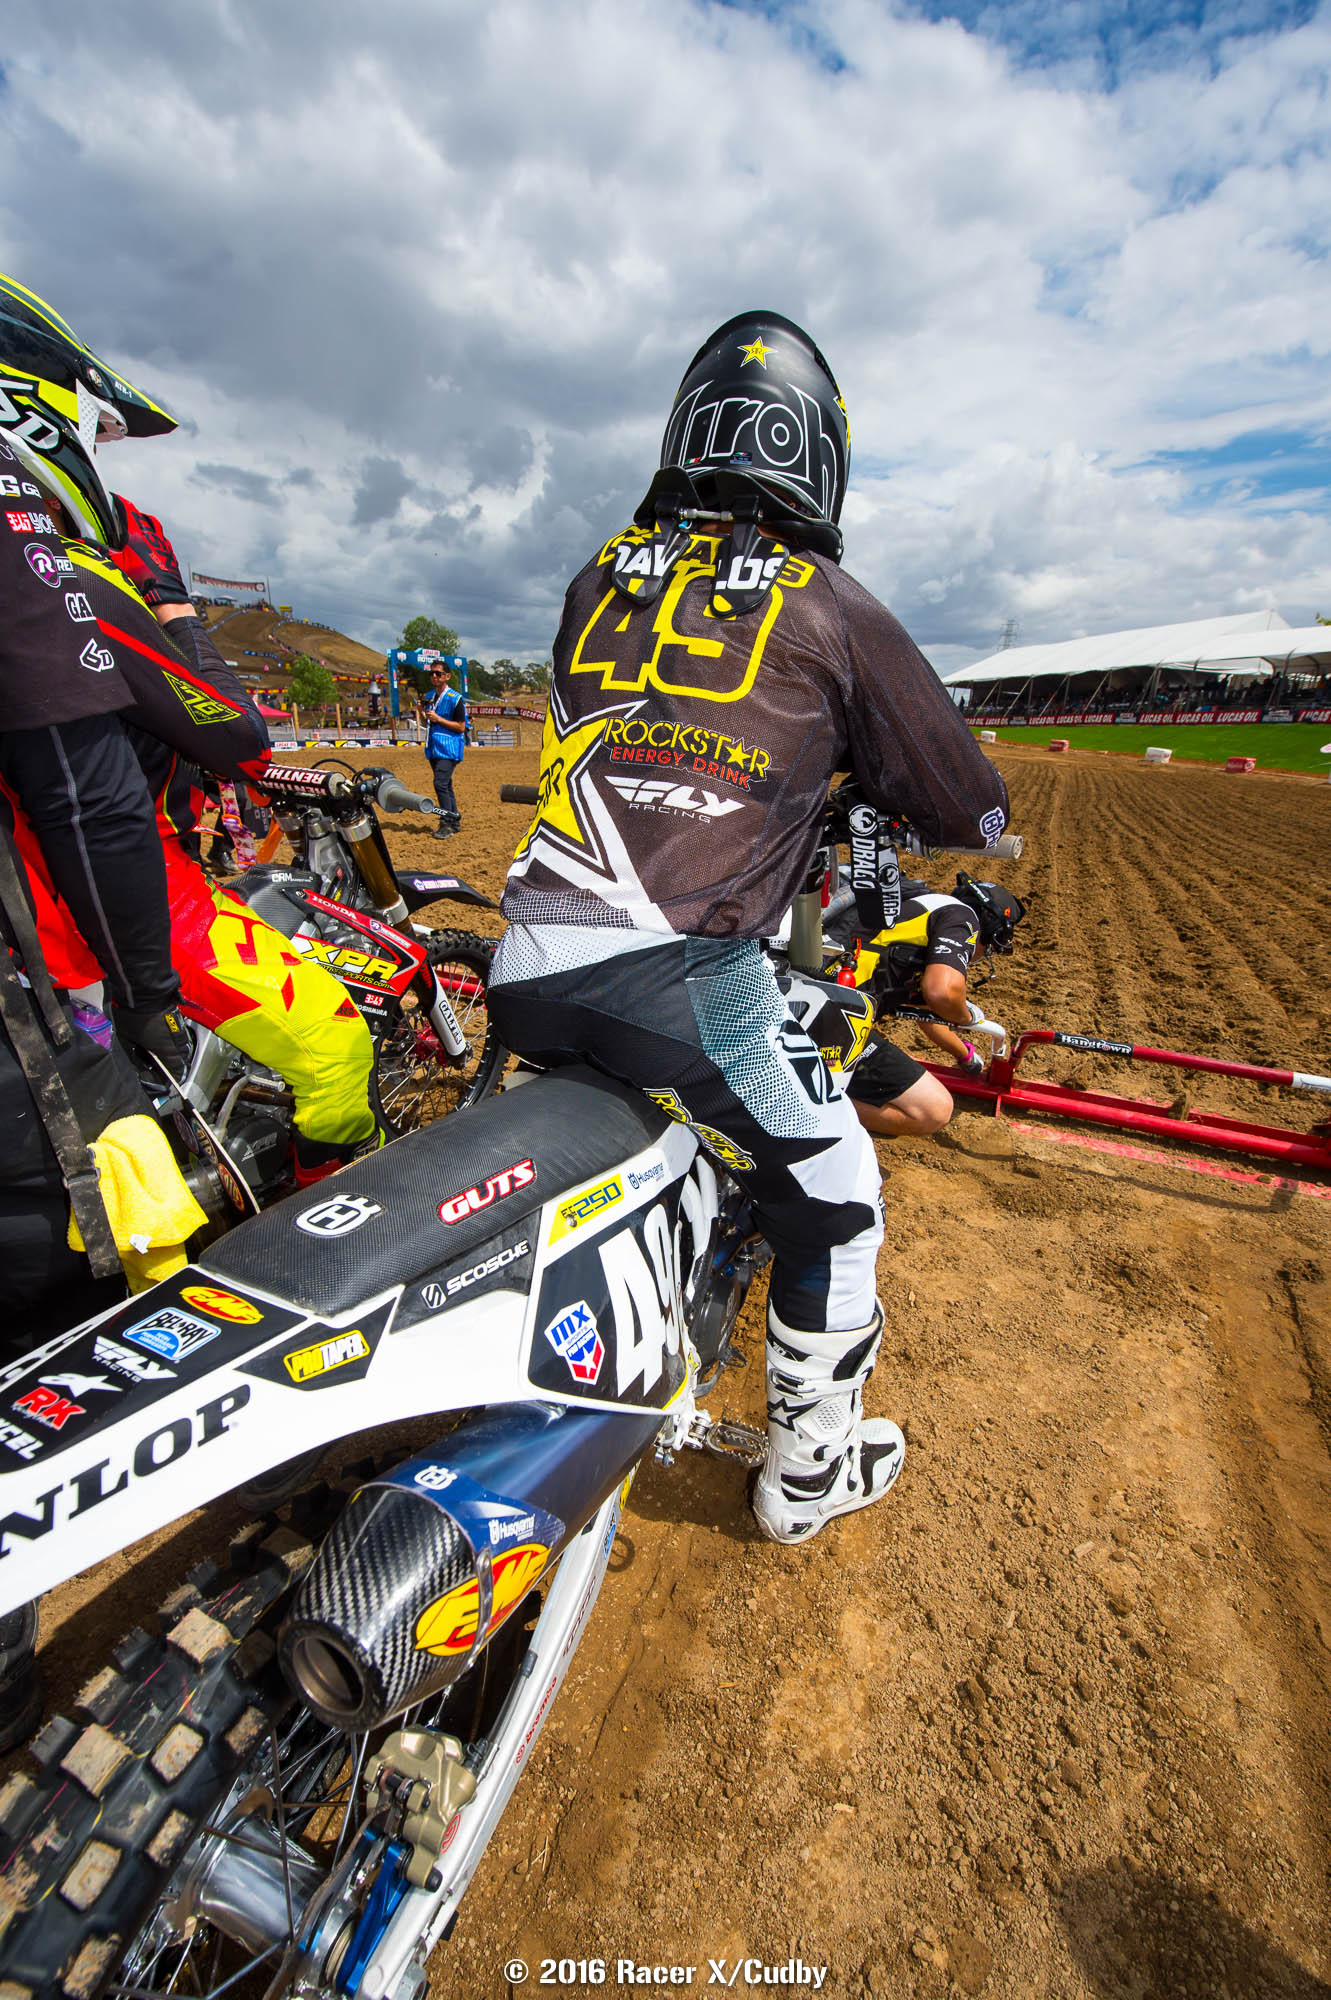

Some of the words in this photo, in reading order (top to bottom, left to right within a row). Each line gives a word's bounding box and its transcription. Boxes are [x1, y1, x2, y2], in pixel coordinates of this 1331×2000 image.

[1216, 712, 1243, 723] LUCAS
[611, 746, 686, 766] ENERGY
[693, 757, 751, 788] DRINK
[629, 803, 711, 824] RACING
[312, 894, 358, 920] HONDA
[356, 1003, 388, 1017] OSHIMURA
[439, 1158, 535, 1224] GUTS
[572, 1181, 622, 1219] 250
[551, 1303, 591, 1347] MX
[15, 1386, 87, 1430] RK
